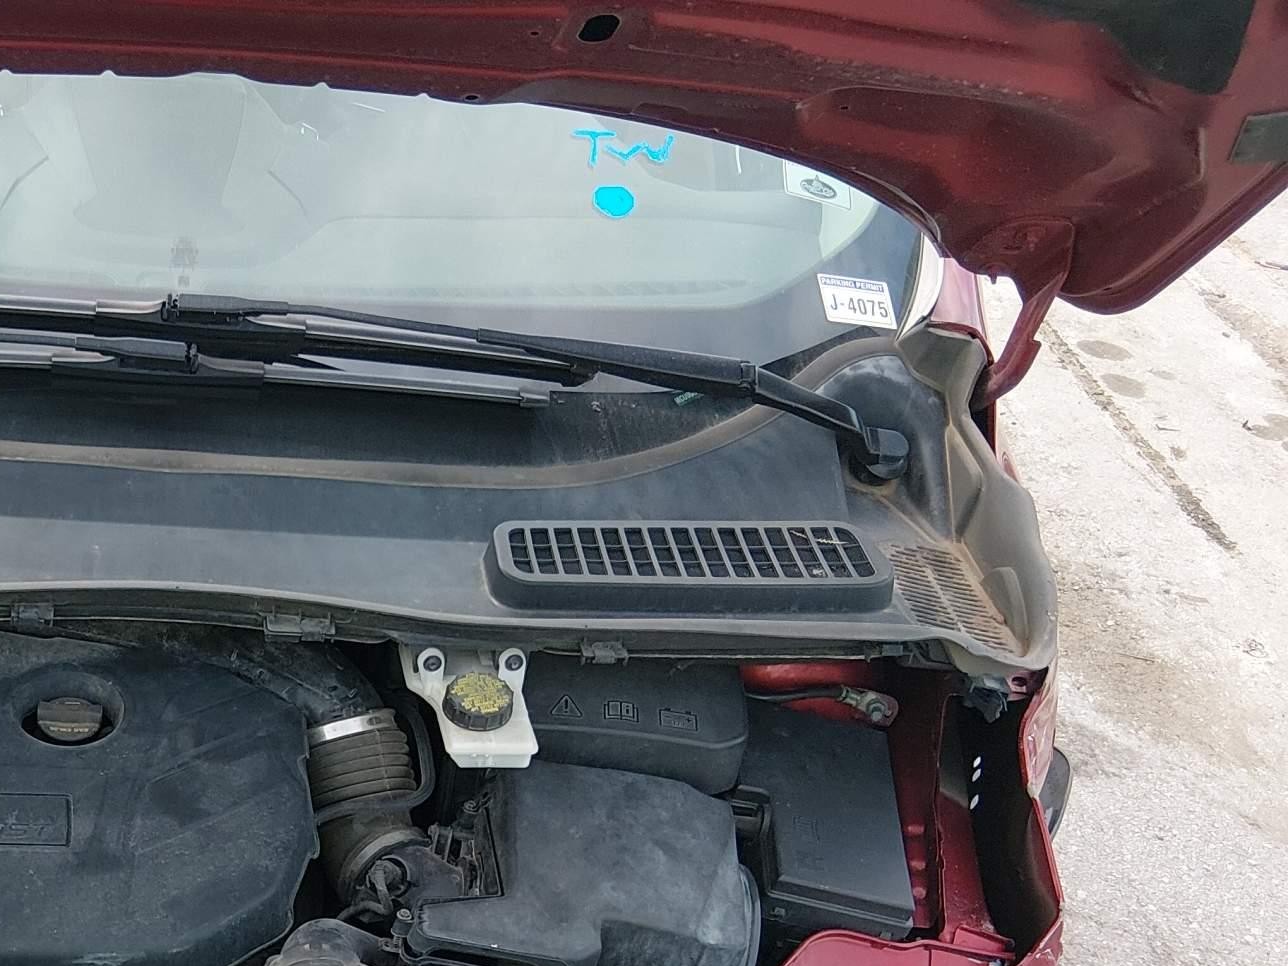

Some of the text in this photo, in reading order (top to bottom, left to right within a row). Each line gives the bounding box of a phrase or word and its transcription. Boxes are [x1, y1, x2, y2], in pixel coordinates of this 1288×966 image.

[820, 276, 885, 294] PARKING PERMIT
[830, 293, 889, 319] J-4075
